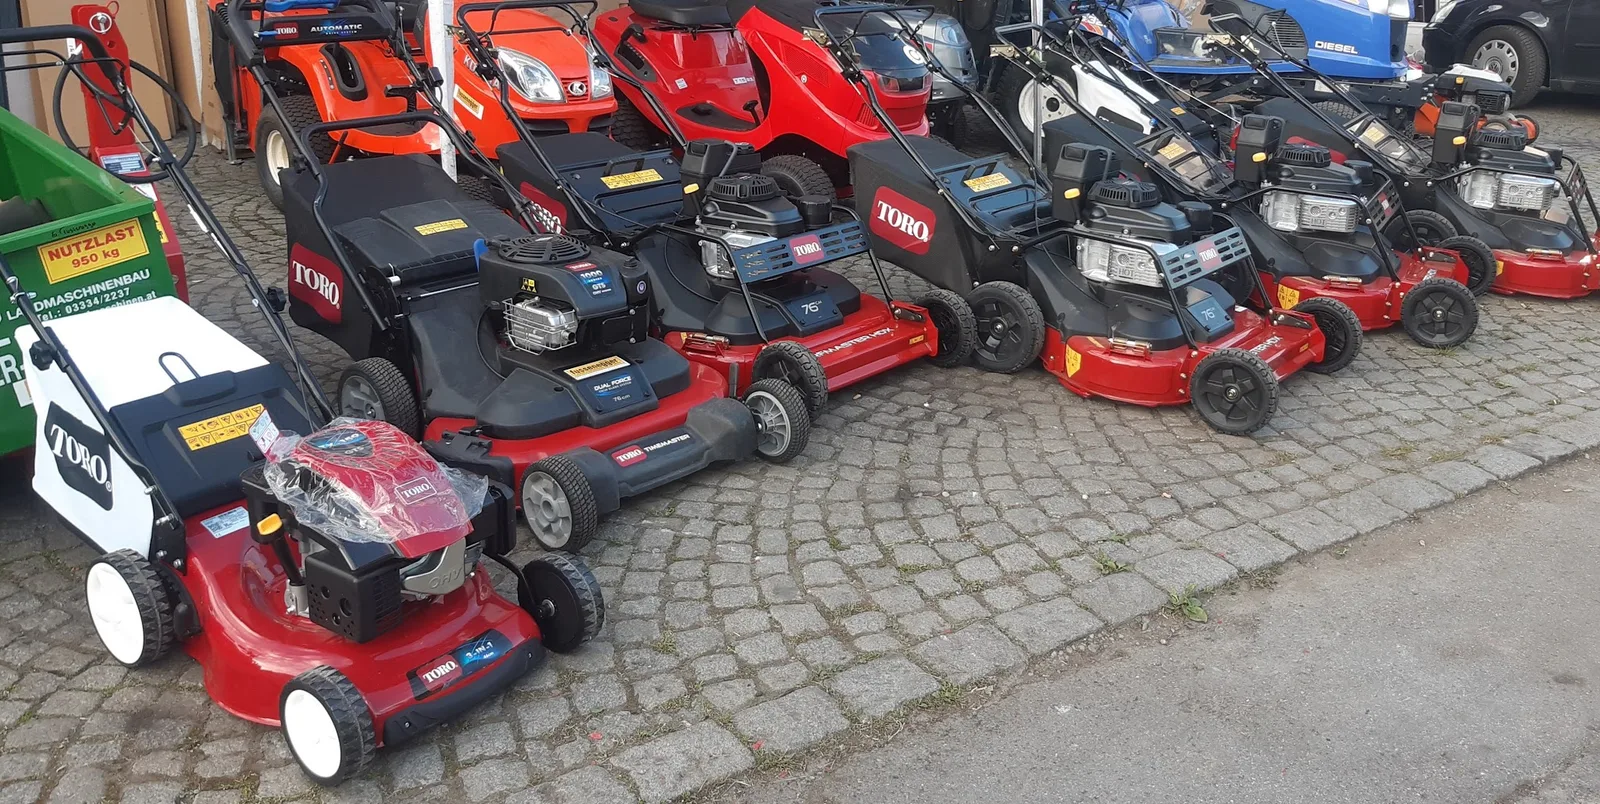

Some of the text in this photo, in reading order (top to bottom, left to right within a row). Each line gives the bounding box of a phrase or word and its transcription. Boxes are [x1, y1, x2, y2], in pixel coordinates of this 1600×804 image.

[276, 23, 363, 35] TORO AUTOMATIC
[1314, 40, 1359, 55] DIESEL
[530, 200, 562, 235] ORO
[876, 199, 930, 243] TORO
[47, 225, 136, 262] NUTZLAST
[793, 242, 822, 257] TORO
[1198, 247, 1218, 262] TORO
[72, 247, 120, 269] 950 kg
[1118, 268, 1134, 277] HOT
[6, 268, 151, 321] LADMASCHINENBAU
[292, 260, 341, 310] TORO
[65, 287, 131, 314] 03334/2237
[593, 382, 612, 392] DUAL
[611, 375, 632, 386] FORCE
[616, 433, 691, 463] TORO TIMEMASTER
[400, 483, 432, 499] TORO
[428, 567, 463, 589] OHV
[422, 660, 459, 684] TORO
